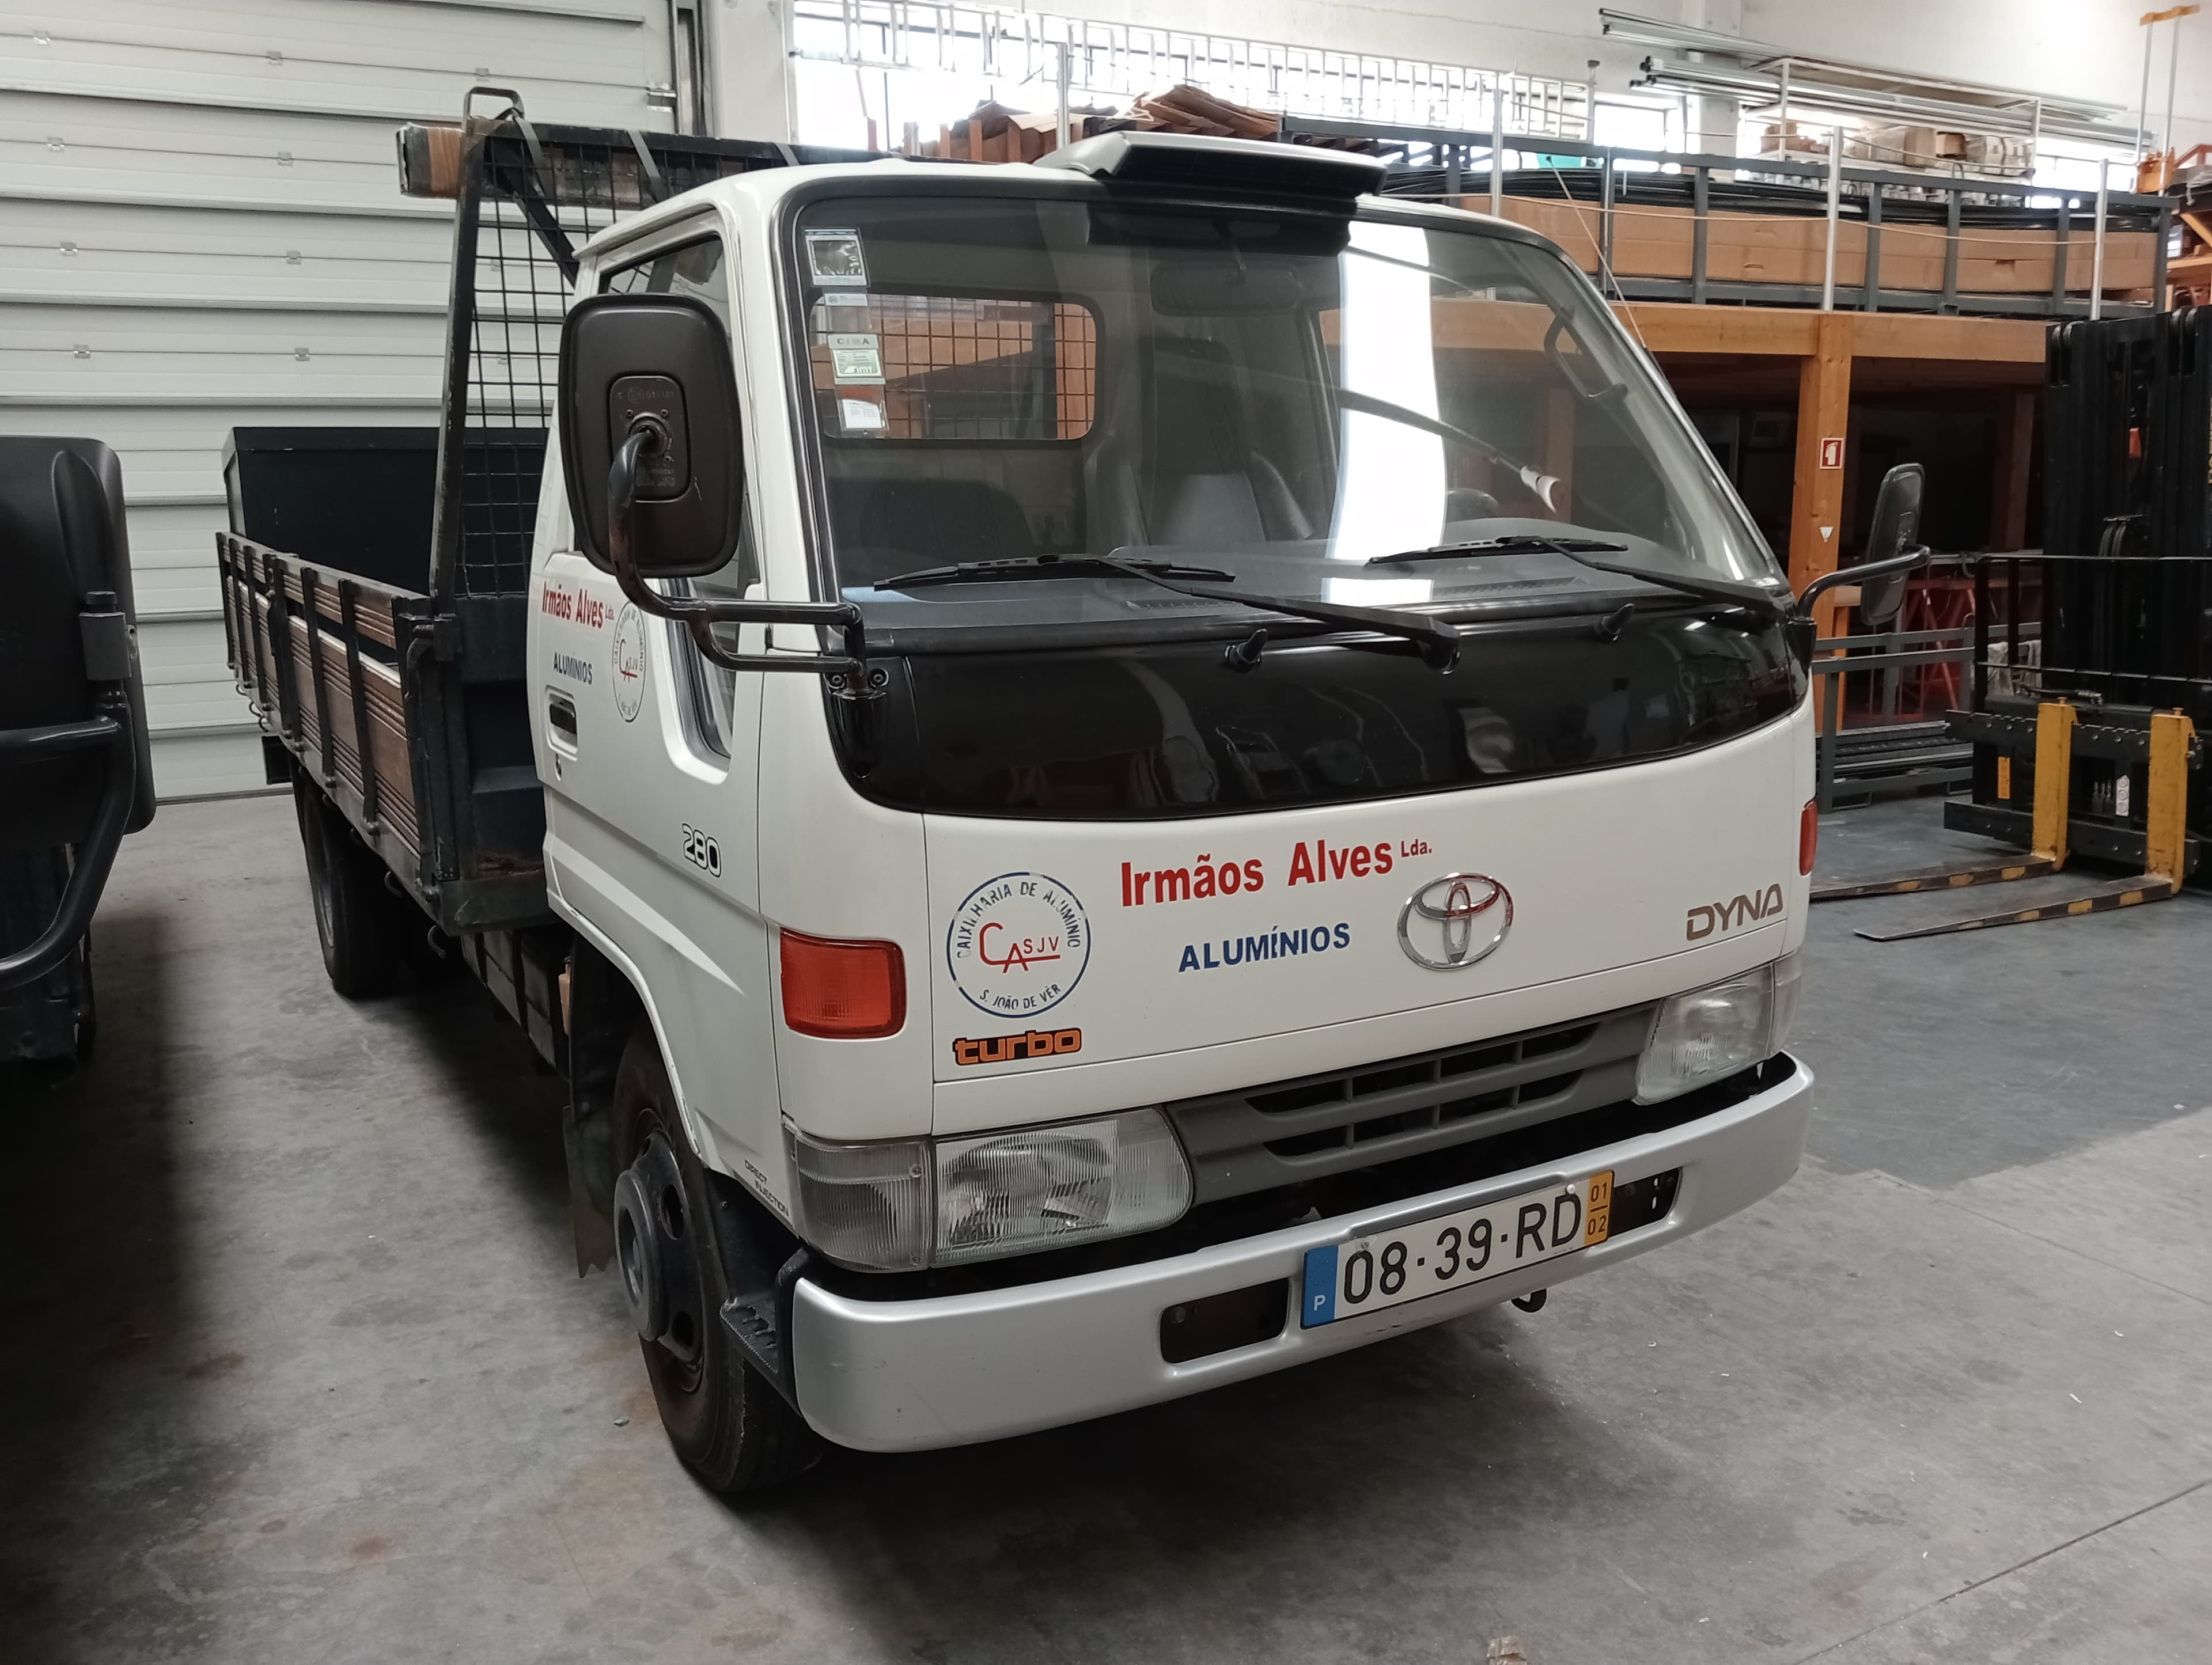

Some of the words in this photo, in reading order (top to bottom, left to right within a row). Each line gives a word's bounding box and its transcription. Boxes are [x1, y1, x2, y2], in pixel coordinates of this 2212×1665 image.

[542, 581, 572, 620] Irmãos
[575, 588, 604, 629] Alves
[553, 652, 593, 685] ALUMÍNIOS
[681, 822, 722, 878] 280
[1121, 853, 1264, 907] Irmãos
[1287, 839, 1393, 886] Alves
[1401, 838, 1433, 858] Lda.
[957, 883, 1013, 959] CAIXILHARIA
[1020, 881, 1038, 897] DE
[1687, 883, 1783, 941] DYNA
[1178, 923, 1351, 973] ALUMÍNIOS
[979, 989, 990, 1003] S.
[992, 995, 1020, 1010] JOÃO
[1022, 996, 1037, 1009] DE
[953, 1028, 1081, 1065] turbo
[1589, 1181, 1608, 1203] 01
[1587, 1215, 1608, 1237] 02
[1313, 1294, 1326, 1311] P
